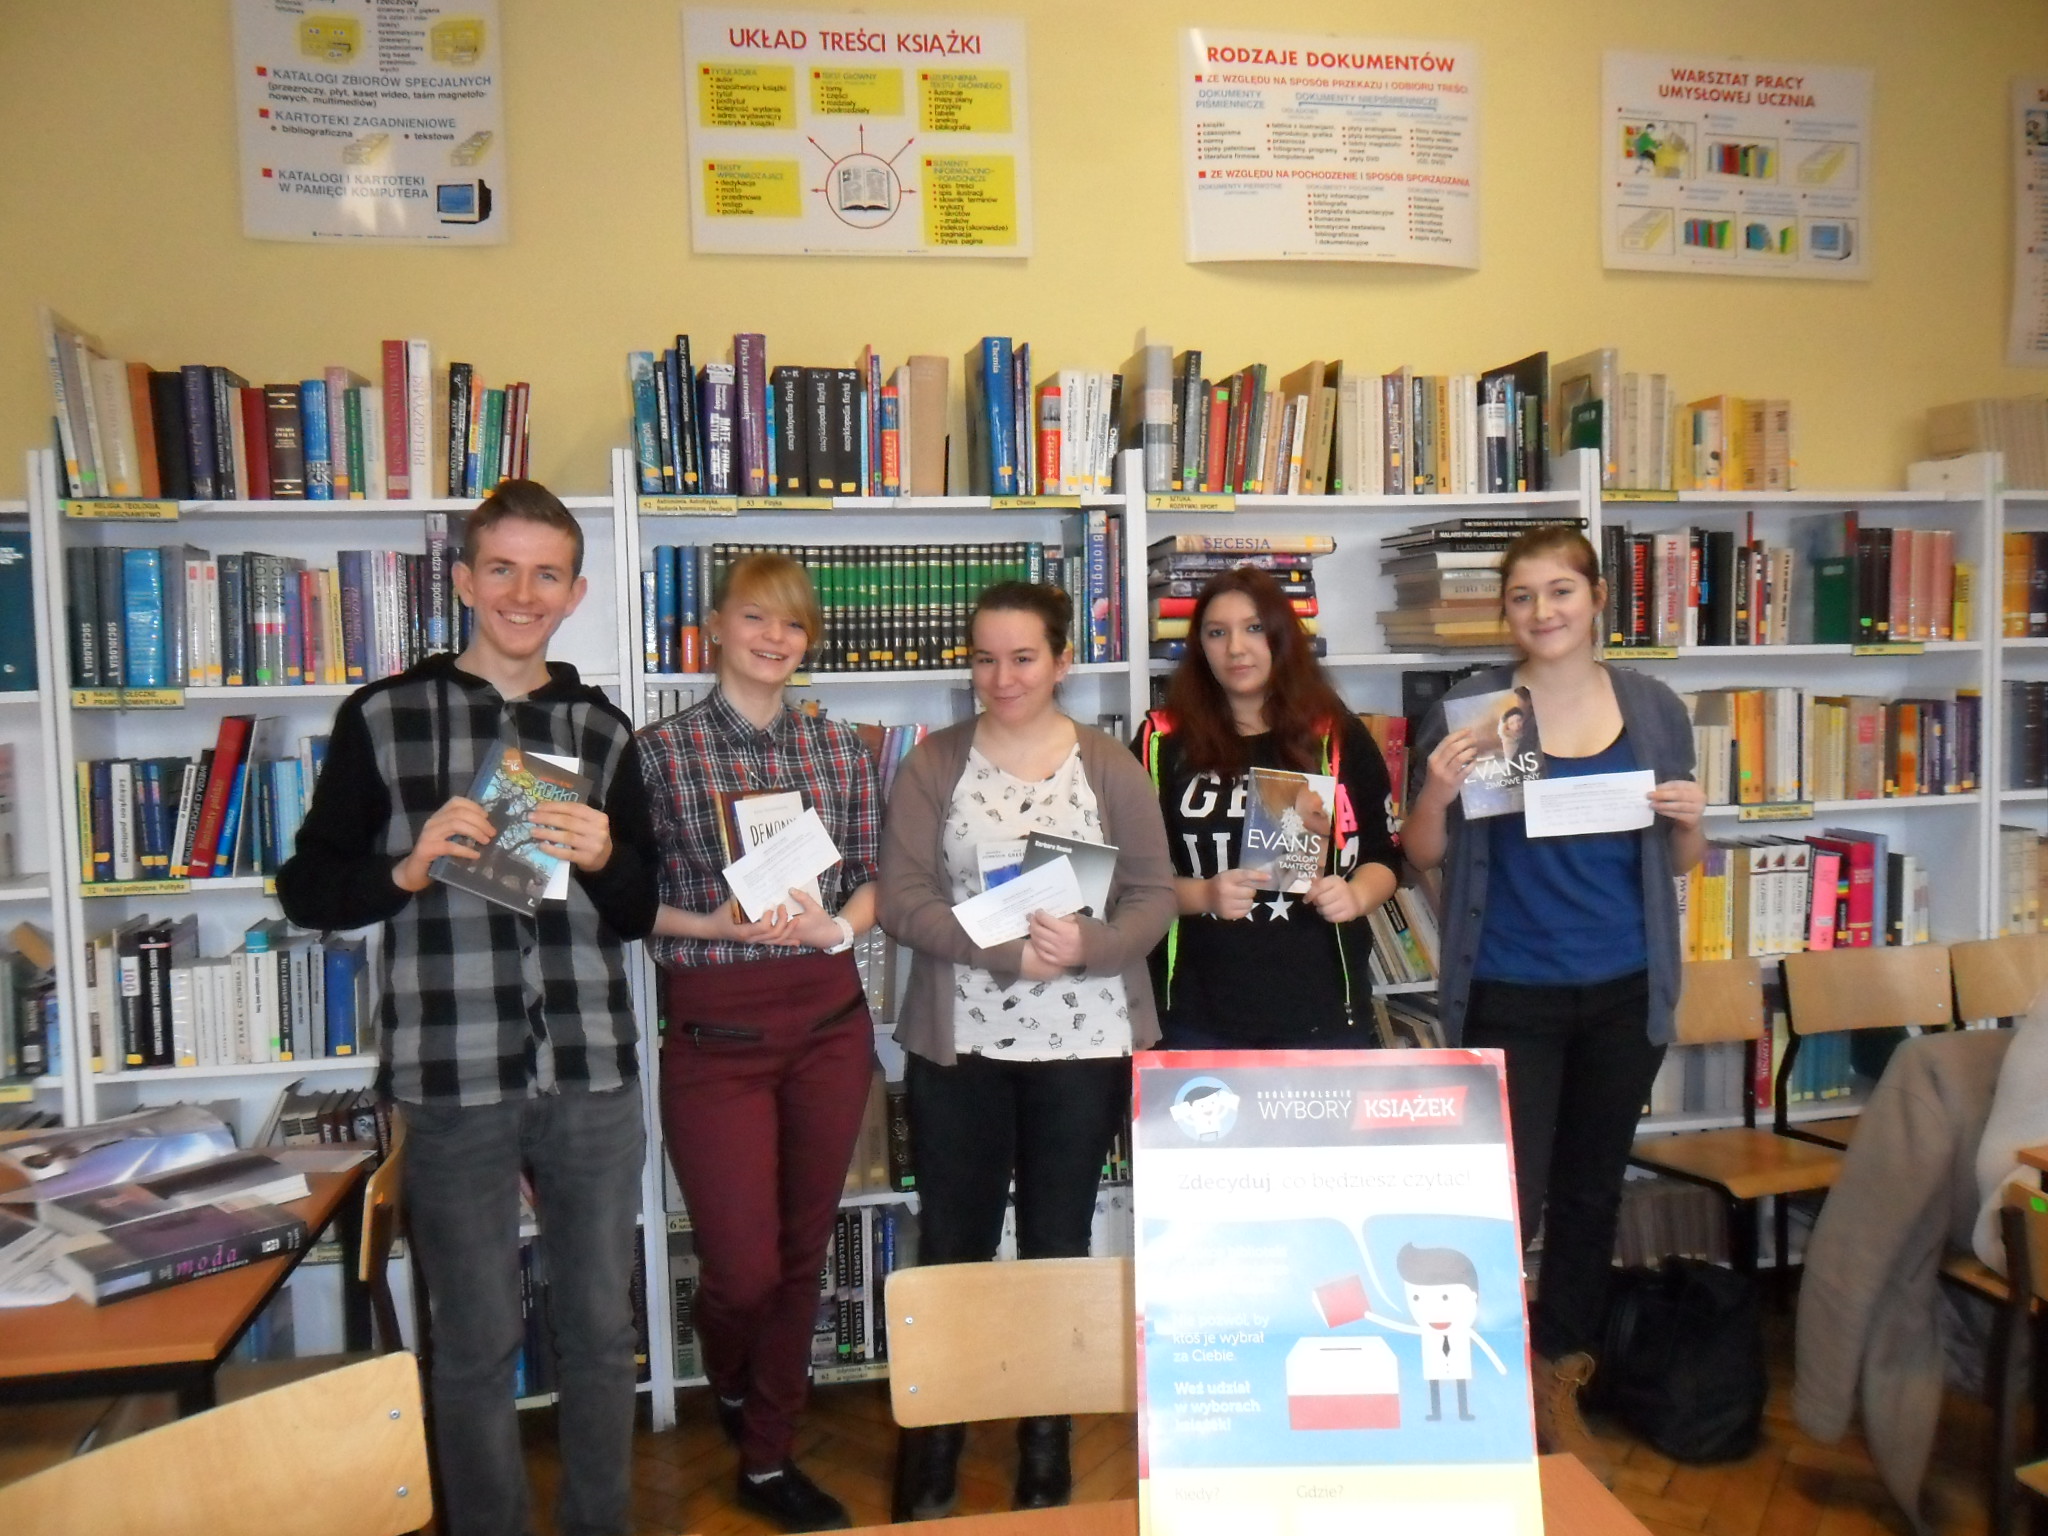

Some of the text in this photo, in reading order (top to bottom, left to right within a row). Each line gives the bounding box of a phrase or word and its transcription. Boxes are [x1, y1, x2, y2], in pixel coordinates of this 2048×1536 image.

[729, 28, 981, 57] UKŁAD TREŚCI KSIĄŻKI
[1207, 46, 1455, 73] RODZAJE DOKUMENTÓW
[273, 69, 491, 88] KATALOGI ZBIORÓW SPECJALNYCH
[1207, 74, 1220, 83] ZE
[1222, 75, 1271, 86] WZGLĘDU
[1274, 77, 1287, 85] NA
[1289, 77, 1330, 87] SPOSÓB
[1332, 79, 1383, 90] PRZEKAZU
[1671, 68, 1805, 90] WARSZTAT PRACY
[1198, 89, 1262, 99] DOKUMENTY
[1658, 84, 1816, 108] UMYSŁOWEJ UCZNIA
[275, 110, 456, 128] KARTOTEKI ZAGADNIENIOWE
[282, 125, 353, 138] bibliograficzna
[414, 132, 455, 141] tekstowa
[278, 169, 426, 187] KATALOGI KARTOTEKI
[1210, 170, 1223, 179] ZE
[1225, 170, 1273, 180] WZGLĘDU
[1276, 170, 1289, 179] NA
[1292, 170, 1358, 181] POCHODZENIE
[1366, 172, 1404, 181] SPOSÓB
[279, 183, 429, 199] W PAMIĘCI KOMPUTERA
[739, 338, 750, 365] Fizyka
[991, 340, 1000, 374] Chemia
[656, 371, 669, 439] KOMPENDIUM FIZYKI
[412, 375, 426, 467] PIELGRZYMKI
[1108, 427, 1117, 458] Chemia
[1424, 473, 1434, 486] 2
[75, 504, 83, 515] 2
[1016, 499, 1037, 507] Chemia
[1154, 498, 1163, 509] 7
[1203, 537, 1271, 551] SECESJA
[432, 540, 443, 572] Wiedza
[1092, 533, 1103, 595] Biologia
[253, 556, 267, 610] POLSKA
[271, 557, 285, 609] POLSKA
[1667, 540, 1678, 624] Historia filmu
[1690, 559, 1700, 588] filmie
[82, 622, 93, 670] SOCJOLOGIA
[107, 621, 119, 669] SOCJOLOGIA
[77, 692, 87, 704] 3
[510, 763, 520, 772] 16
[197, 765, 208, 794] WIEDZA
[1485, 772, 1540, 790] ZIMOWE SNY
[118, 778, 129, 821] Leksykon
[1247, 828, 1322, 855] EVANS
[1279, 861, 1318, 872] TAMTEGO
[1285, 854, 1320, 864] KOLORY
[1297, 870, 1318, 879] LATA
[123, 967, 136, 995] 100
[1258, 1095, 1456, 1123] WYBORY KSIĄŻEK
[1178, 1170, 1397, 1193] Zdecyduj co będziesz
[669, 1219, 677, 1230] 6
[176, 1244, 238, 1276] moda
[837, 1222, 848, 1344] ENCYKLOPEDIA TECHNIKI
[853, 1222, 864, 1344] ENCYKLOPEDIA TECHNIKI
[1253, 1313, 1270, 1330] by
[1203, 1330, 1217, 1348] je
[1219, 1329, 1265, 1346] wybrał
[1173, 1351, 1189, 1363] za
[1174, 1380, 1251, 1395] Weź udział
[1174, 1399, 1261, 1415] w wyborach
[1174, 1484, 1345, 1503] Kiedy? Gdzie?
